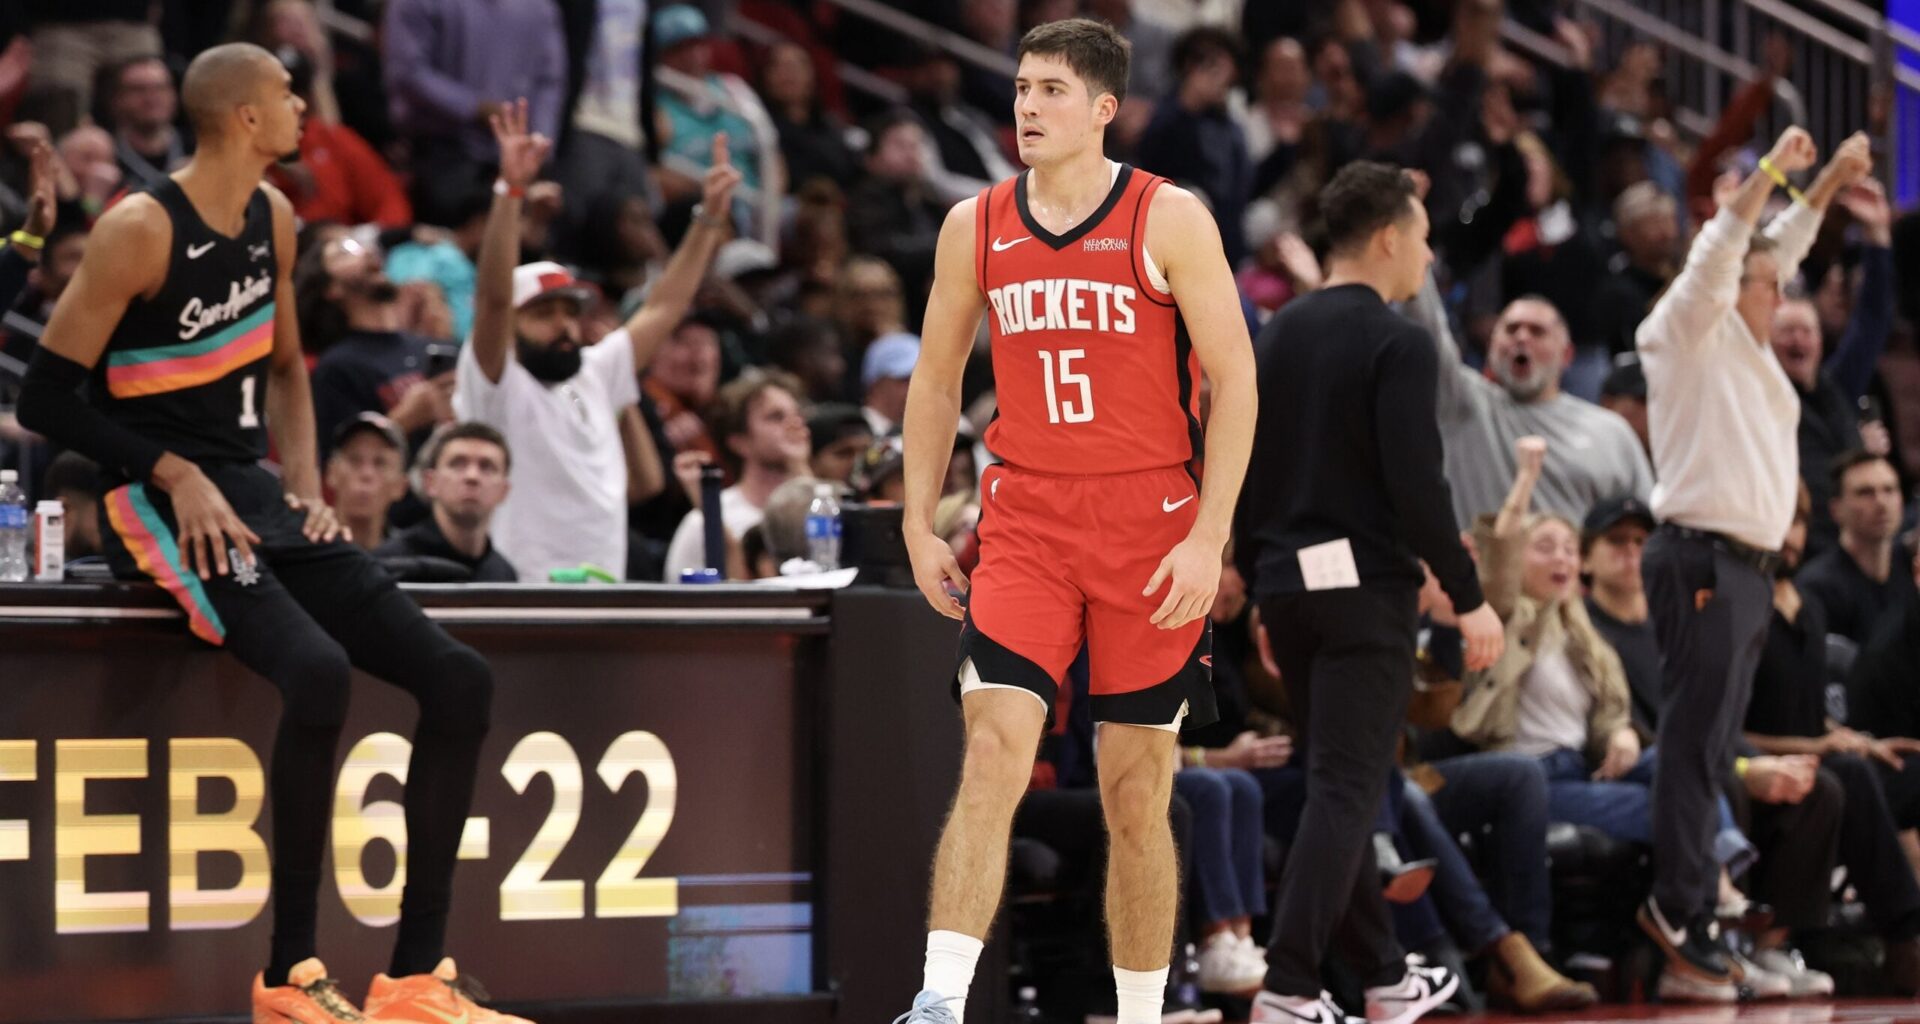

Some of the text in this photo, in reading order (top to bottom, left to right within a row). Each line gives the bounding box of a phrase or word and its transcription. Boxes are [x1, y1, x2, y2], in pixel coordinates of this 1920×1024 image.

[1083, 238, 1128, 246] MEMORIAL
[1083, 244, 1128, 252] HERMANN
[987, 278, 1136, 336] ROCKETS
[239, 376, 259, 428] 1
[1038, 348, 1095, 424] 15
[331, 730, 679, 928] 6-22
